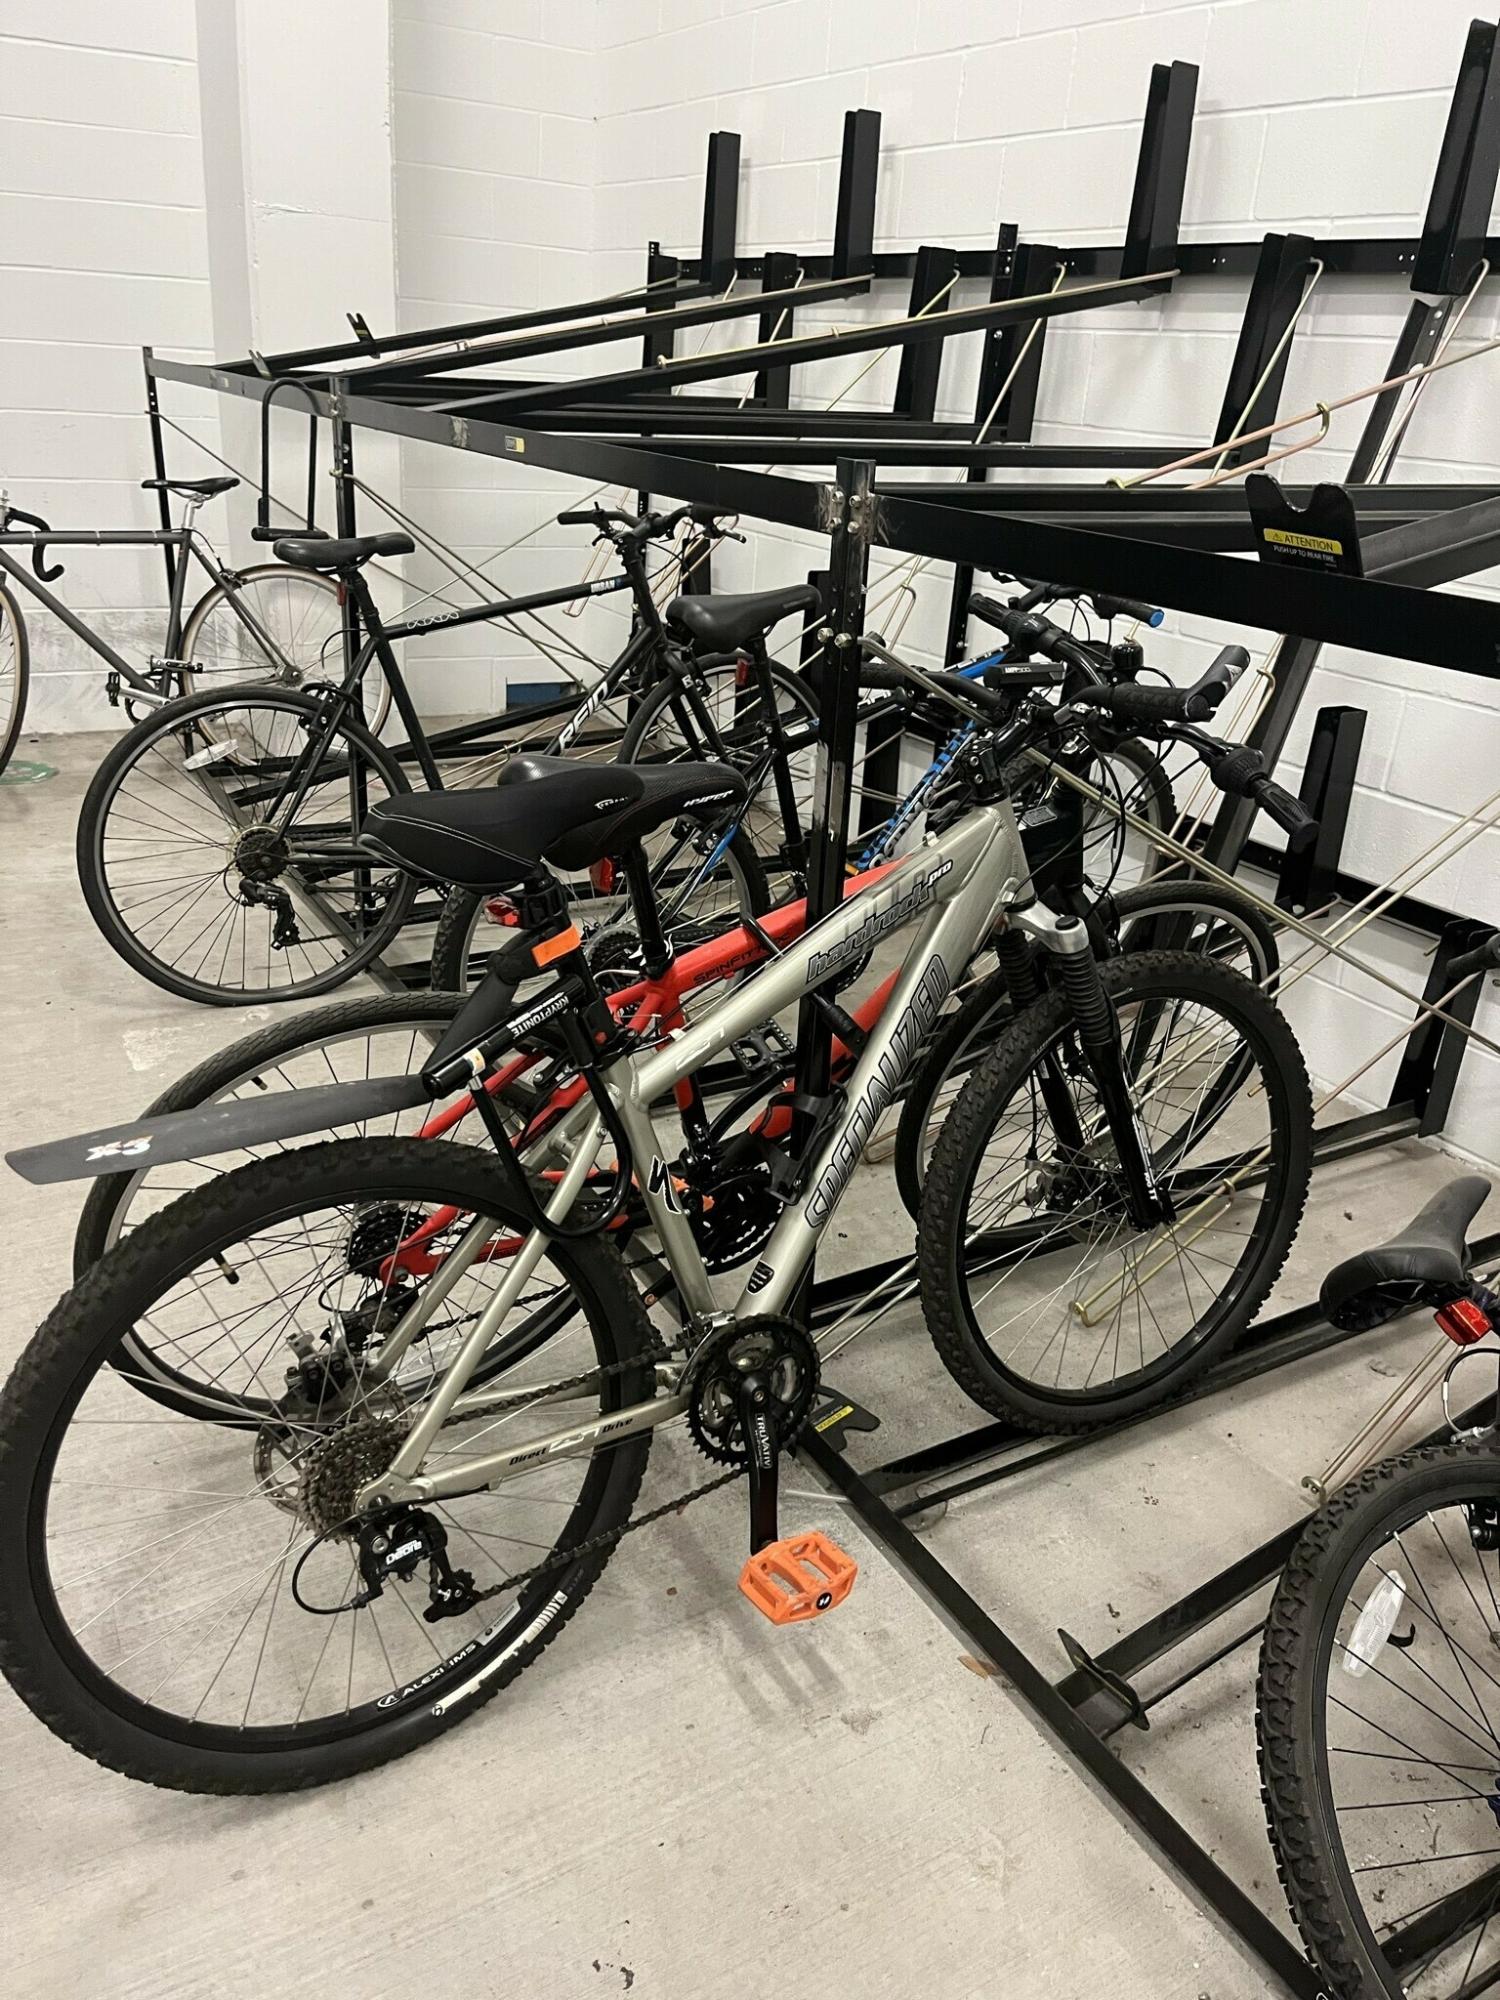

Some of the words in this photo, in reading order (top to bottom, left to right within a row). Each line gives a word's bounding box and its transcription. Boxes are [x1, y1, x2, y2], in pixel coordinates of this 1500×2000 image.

[1284, 534, 1334, 552] ATTENTION
[560, 681, 608, 750] REID
[807, 881, 930, 984] hardrock
[927, 859, 953, 887] pro
[511, 995, 570, 1039] KRYPTONITE
[509, 1447, 547, 1466] Direct
[602, 1418, 633, 1434] Drive
[757, 1415, 771, 1466] TRUVATIV
[385, 1540, 423, 1566] Deore
